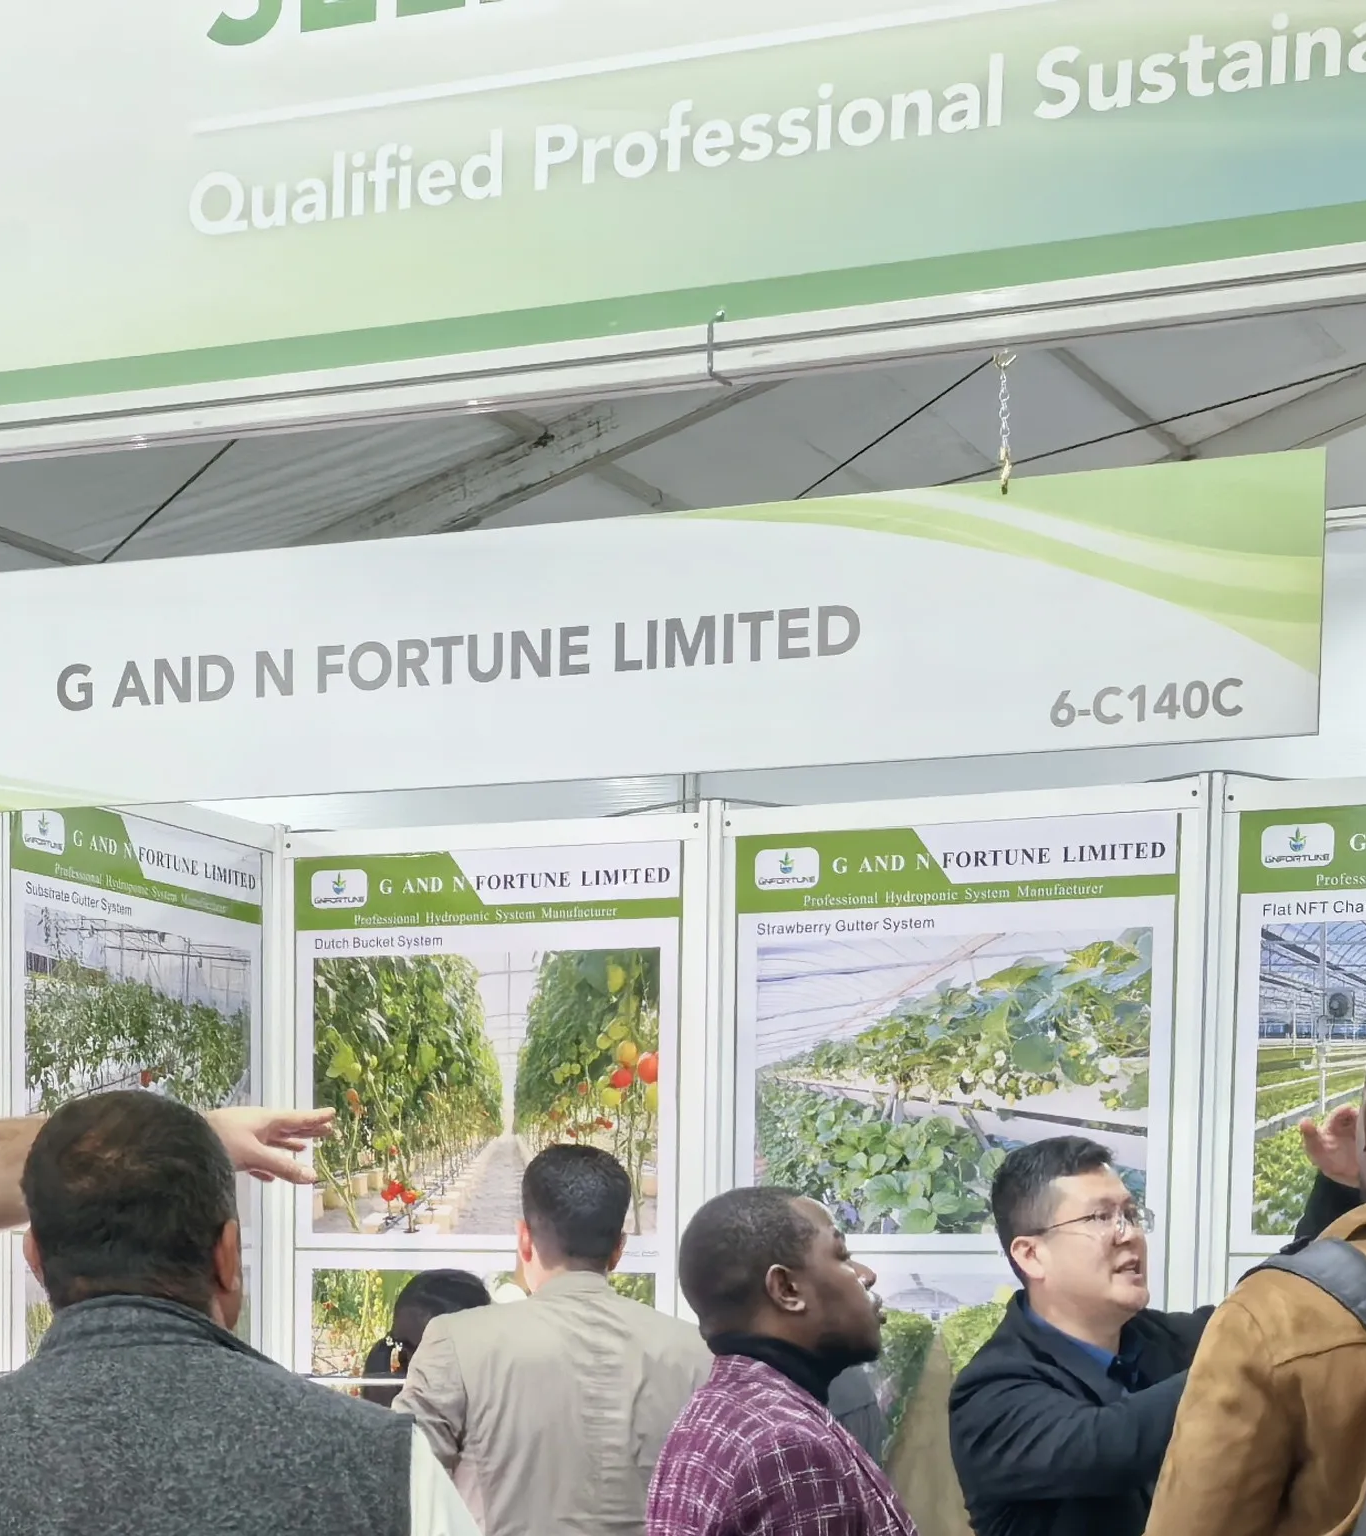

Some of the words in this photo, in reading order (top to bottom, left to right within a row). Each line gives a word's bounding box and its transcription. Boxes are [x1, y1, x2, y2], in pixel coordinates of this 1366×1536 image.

[188, 127, 503, 237] Qualified
[533, 52, 1005, 193] Professional
[57, 663, 93, 711] G
[112, 654, 235, 707] AND
[255, 648, 294, 698] N
[317, 625, 589, 694] FORTUNE
[614, 605, 860, 672] LIMITED
[1050, 678, 1243, 727] 6-C140C
[1349, 832, 1366, 852] G
[73, 829, 83, 847] G
[89, 836, 117, 855] AND
[138, 846, 199, 876] FORTUNE
[203, 862, 257, 890] LIMITED
[832, 858, 848, 875] G
[859, 855, 905, 873] AND
[916, 853, 930, 870] N
[942, 847, 1051, 869] FORTUNE
[1063, 841, 1166, 863] LIMITED
[379, 879, 393, 896] G
[403, 877, 443, 894] AND
[453, 875, 465, 891] N
[475, 871, 571, 892] FORTUNE
[580, 866, 671, 887] LIMITED
[803, 892, 878, 907] Professional
[885, 890, 958, 905] Hydroponic
[964, 886, 1010, 901] System
[1016, 882, 1104, 898] Manufacturer
[25, 880, 70, 904] Substrate
[71, 892, 99, 909] Gutter
[100, 897, 132, 917] System
[1261, 903, 1293, 918] Flat
[1296, 901, 1328, 915] NFT
[354, 912, 420, 926] Professional
[425, 910, 490, 925] Hydroponic
[495, 908, 535, 922] System
[541, 906, 617, 920] Manufacturer
[757, 920, 831, 936] Strawberry
[835, 918, 879, 932] Gutter
[882, 916, 935, 933] System
[314, 936, 349, 950] Dutch
[353, 935, 395, 950] Bucket
[398, 934, 443, 950] System
